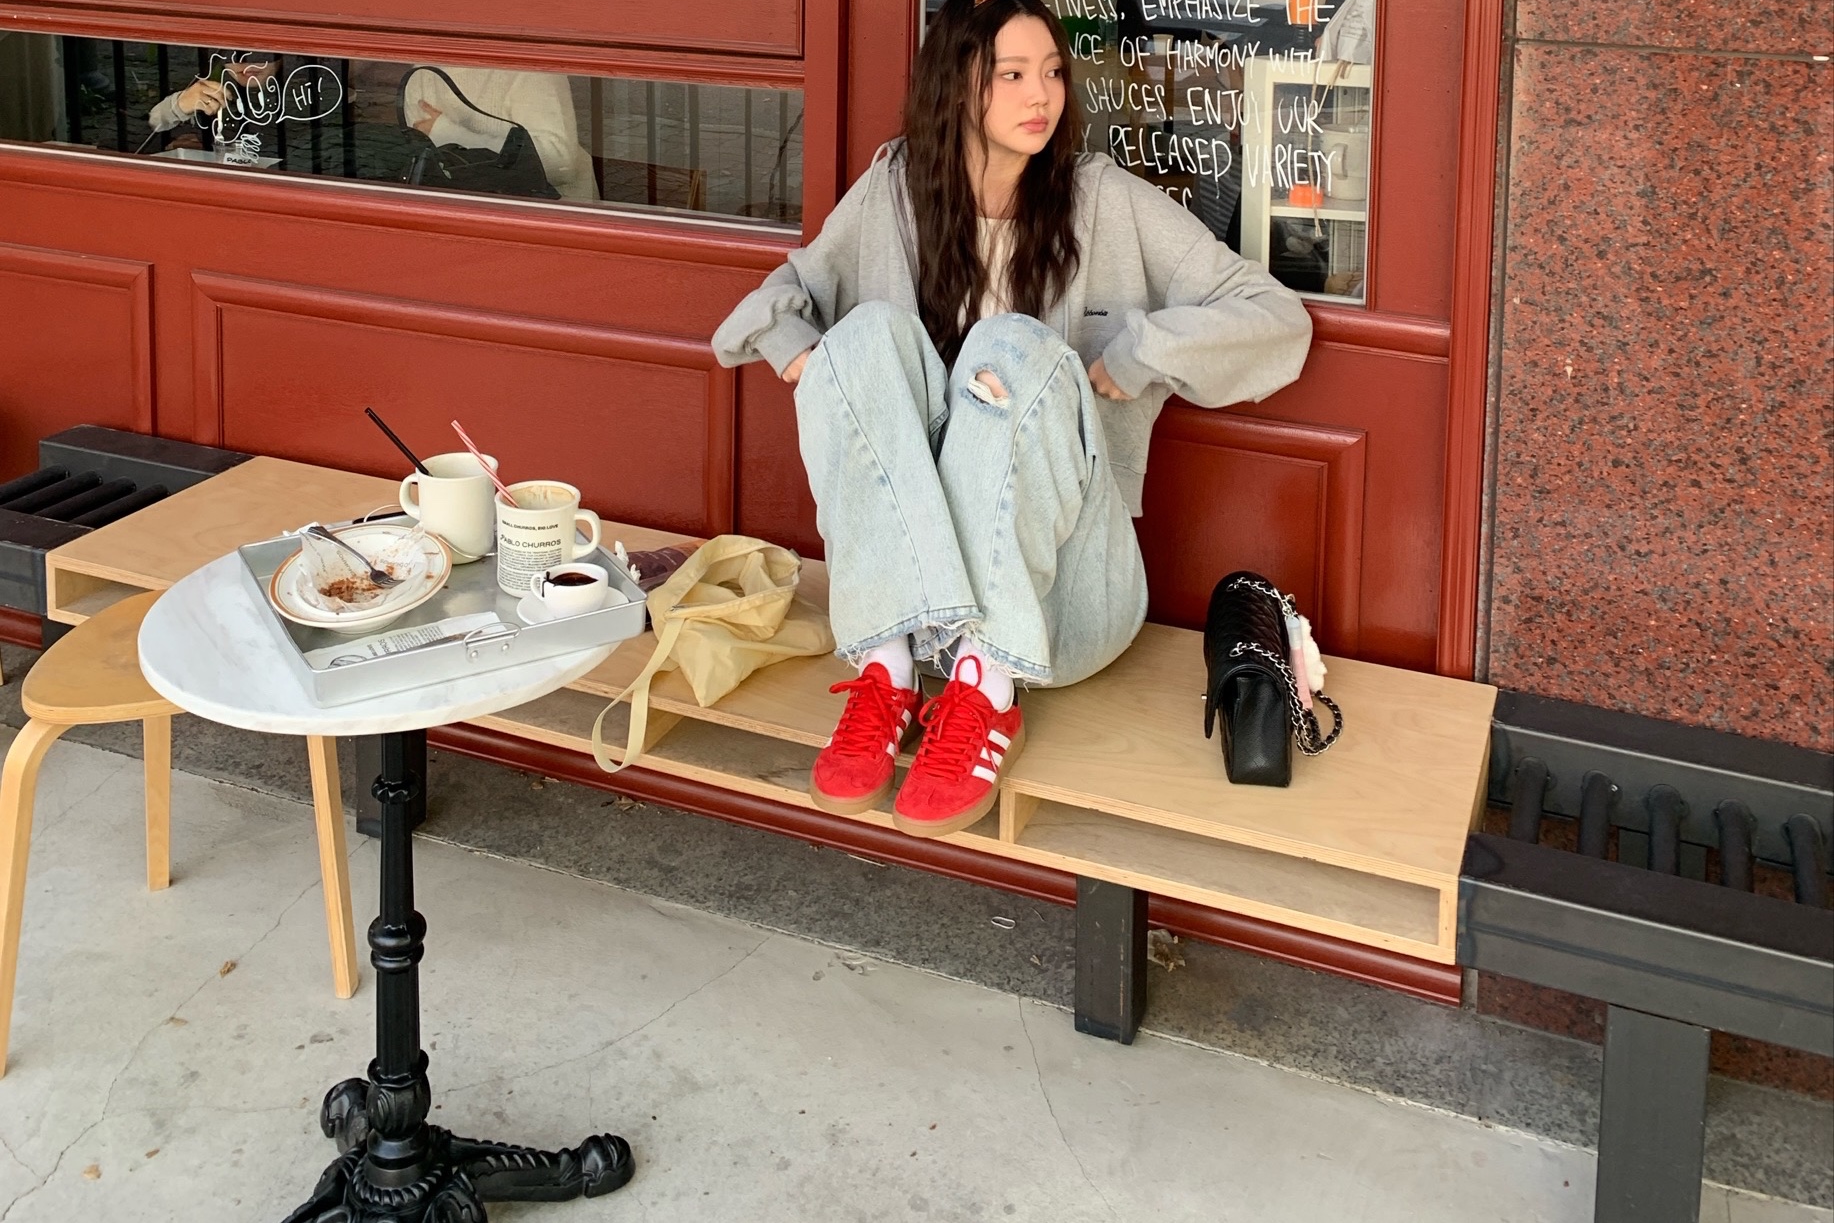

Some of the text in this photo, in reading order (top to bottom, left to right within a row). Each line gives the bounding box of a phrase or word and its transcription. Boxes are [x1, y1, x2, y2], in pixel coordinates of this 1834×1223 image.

[1120, 35, 1150, 71] OF
[1166, 39, 1261, 77] HARMONY
[1269, 48, 1326, 79] WITH
[1278, 98, 1323, 135] OUR
[1108, 124, 1233, 185] RELEASED
[1245, 143, 1337, 192] VARIETY
[521, 538, 562, 549] CHURROS
